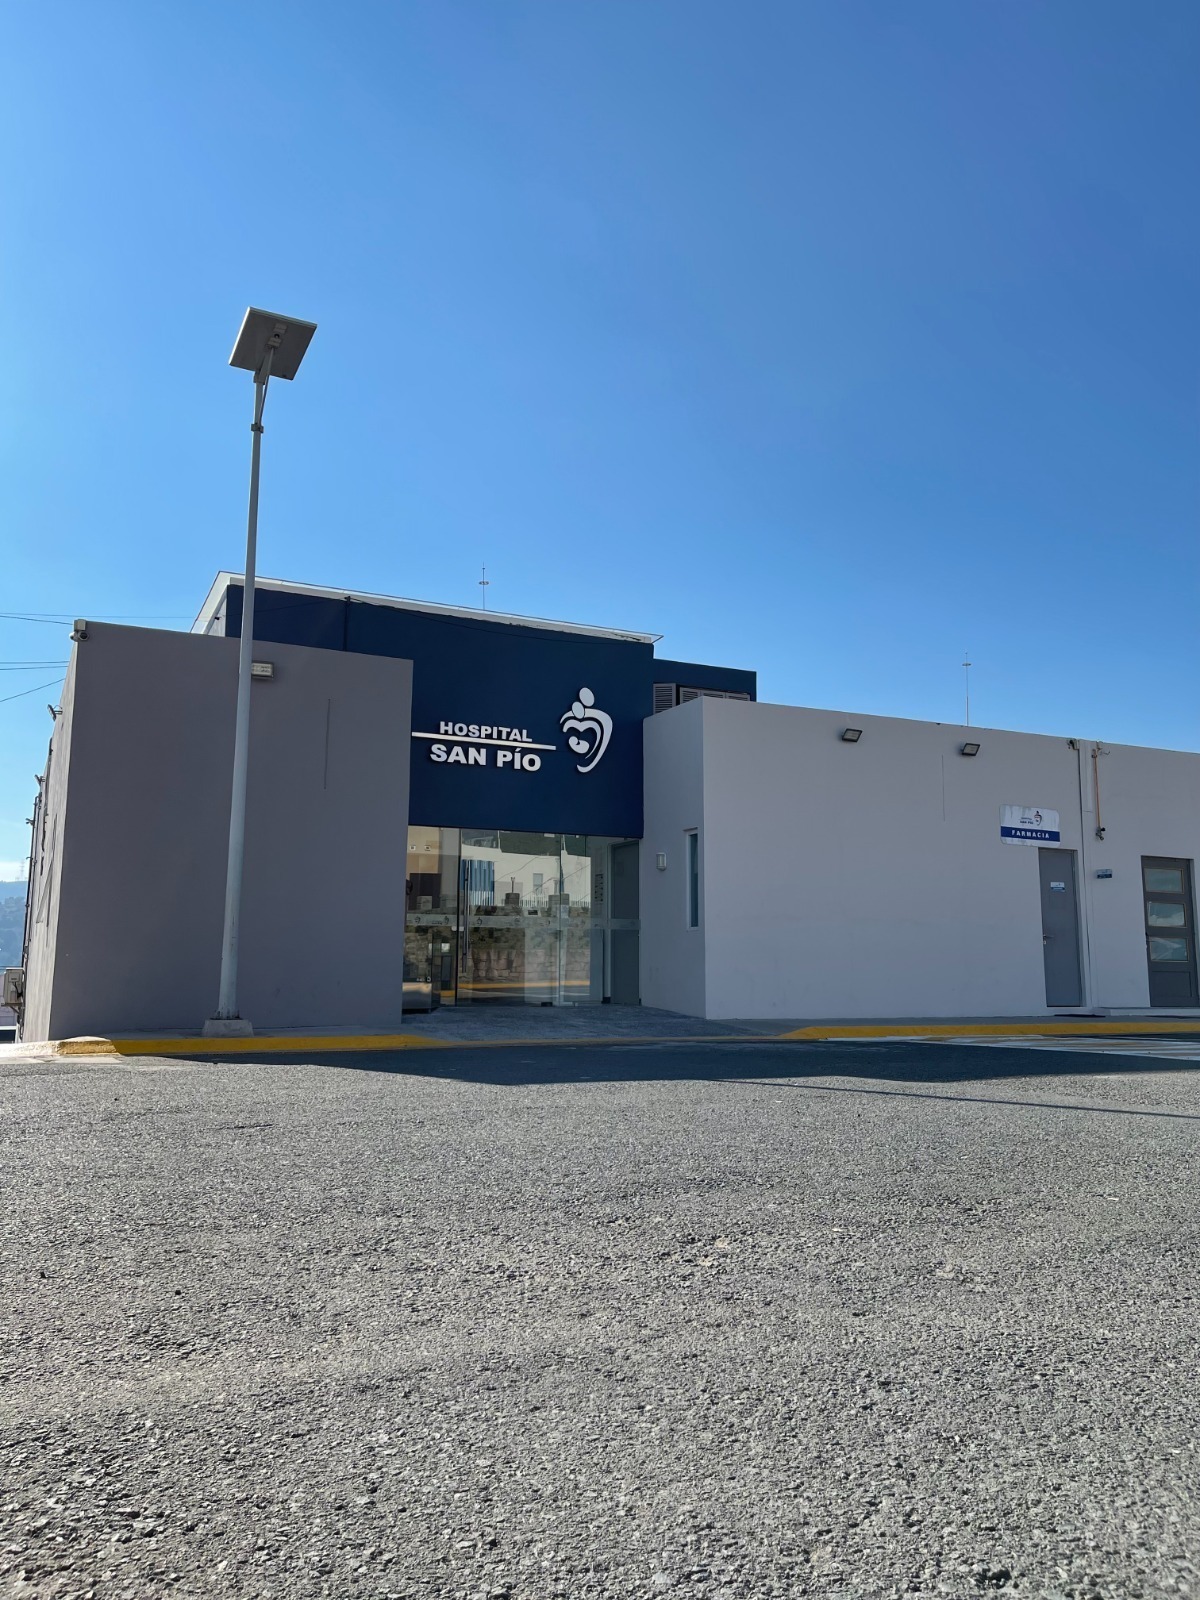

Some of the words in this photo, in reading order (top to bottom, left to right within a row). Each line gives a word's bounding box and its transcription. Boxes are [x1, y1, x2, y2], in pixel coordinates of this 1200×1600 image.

[440, 721, 533, 742] HOSPITAL
[430, 743, 487, 766] SAN
[496, 747, 542, 772] PÍO
[1011, 829, 1050, 839] FARMACIA
